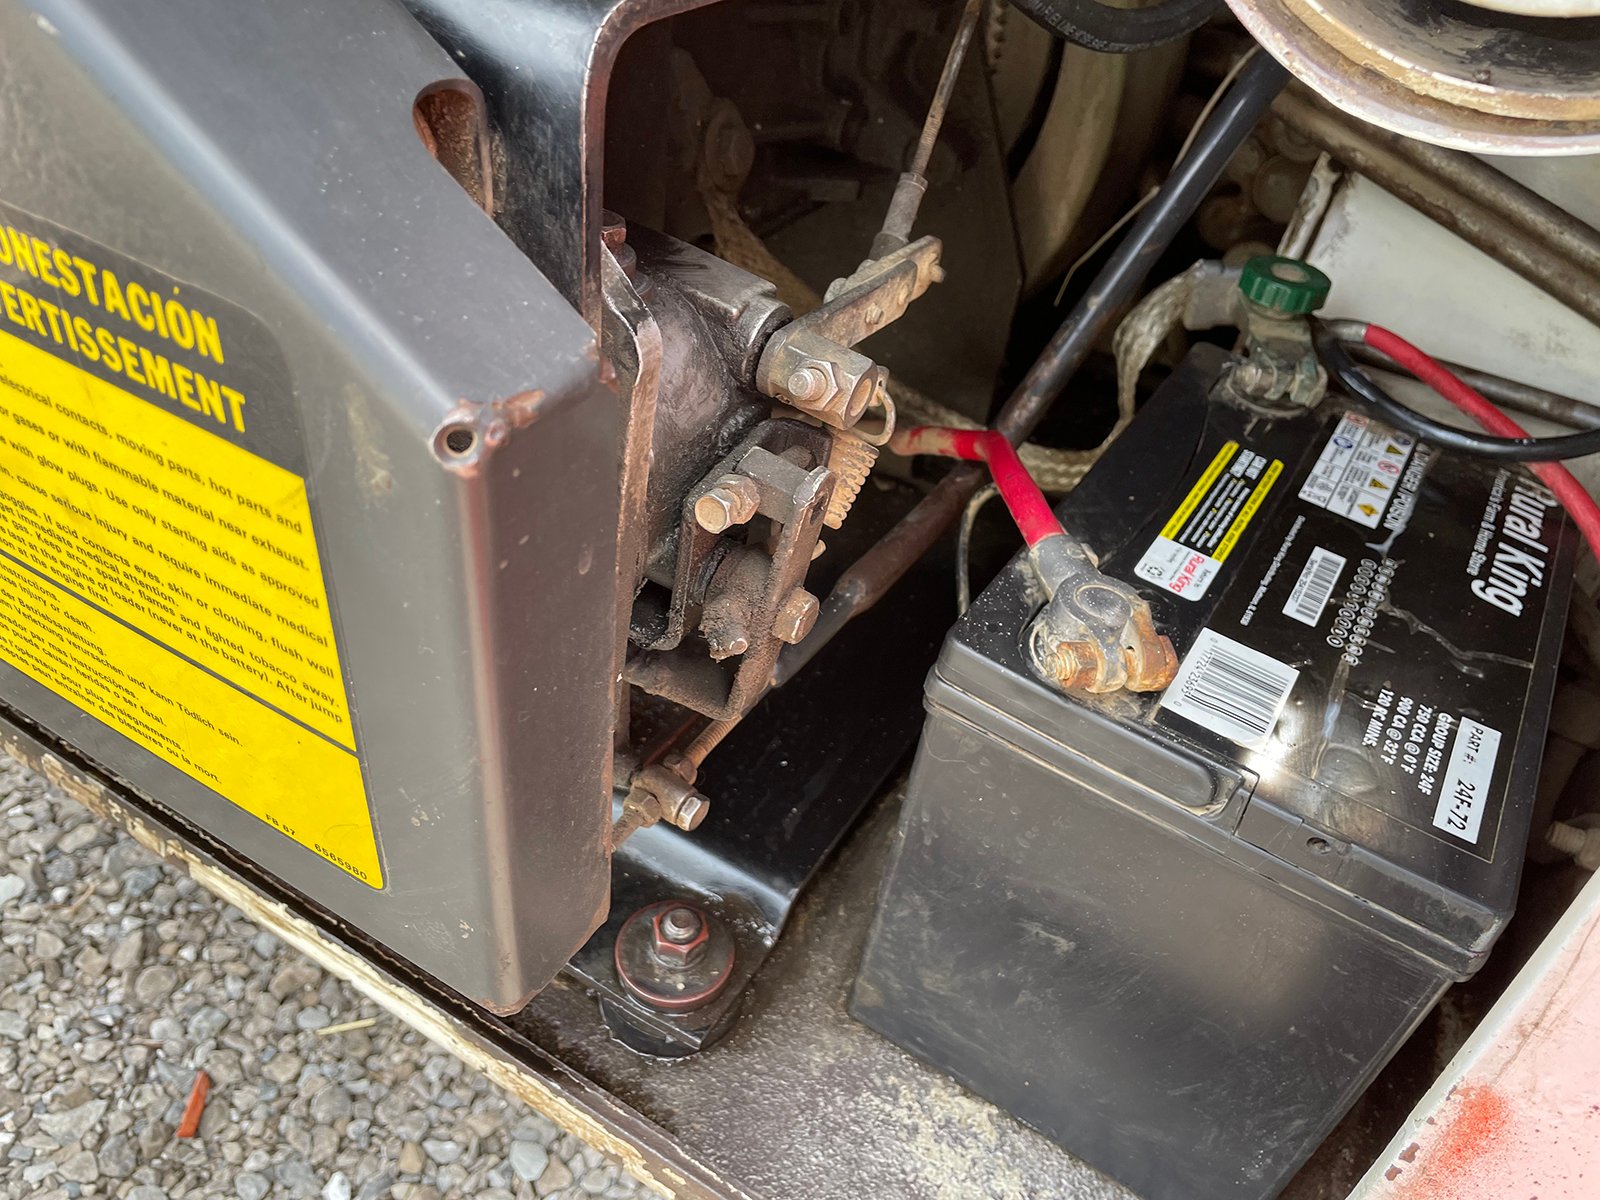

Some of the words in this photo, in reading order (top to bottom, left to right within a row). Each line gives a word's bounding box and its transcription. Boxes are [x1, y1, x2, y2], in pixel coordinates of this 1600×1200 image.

[0, 281, 246, 433] ERTISSEMENT
[55, 403, 112, 438] contacts,
[116, 433, 164, 466] moving
[167, 459, 204, 485] parts,
[208, 477, 232, 498] hot
[236, 494, 271, 518] parts
[276, 514, 301, 533] and
[1400, 451, 1428, 491] DANGER
[12, 413, 45, 435] gases
[47, 431, 59, 442] or
[62, 438, 90, 458] with
[92, 451, 158, 493] flammable
[162, 489, 214, 522] material
[218, 518, 246, 538] near
[251, 535, 309, 571] exhaust.
[1483, 498, 1502, 522] Farm
[9, 440, 33, 458] with
[36, 455, 63, 474] glow
[67, 471, 101, 494] plugs.
[104, 487, 128, 508] Use
[131, 504, 156, 524] only
[161, 519, 207, 552] starting
[211, 546, 236, 565] aids
[241, 561, 255, 574] as
[260, 571, 319, 608] approved
[1382, 491, 1411, 531] POISON
[1481, 520, 1496, 532] &
[1502, 476, 1558, 553] Rural
[15, 509, 73, 548] immediate
[75, 544, 119, 574] medical
[122, 570, 178, 606] attention.
[1474, 528, 1494, 553] Home
[16, 475, 47, 497] cause
[50, 493, 92, 520] serious
[93, 514, 127, 541] injury
[132, 536, 154, 553] and
[157, 550, 200, 578] require
[204, 572, 271, 616] immediate
[276, 614, 327, 647] medical
[17, 546, 28, 558] at
[29, 553, 47, 568] the
[49, 565, 85, 590] engine
[86, 585, 113, 606] first.
[1184, 554, 1205, 578] Rural
[1466, 551, 1487, 576] Store
[1470, 541, 1546, 617] King
[42, 512, 52, 525] If
[55, 521, 78, 539] acid
[81, 536, 130, 567] contacts
[133, 564, 164, 586] eyes,
[167, 582, 192, 601] skin
[196, 598, 208, 609] or
[212, 607, 267, 642] clothing,
[270, 636, 302, 661] flush
[306, 657, 333, 678] well
[1168, 574, 1190, 593] King
[6, 528, 26, 546] last
[27, 541, 39, 553] at
[39, 547, 55, 563] the
[59, 559, 95, 585] engine
[97, 581, 108, 592] of
[109, 586, 145, 612] loader
[147, 607, 182, 633] (never
[186, 630, 198, 643] at
[199, 637, 219, 654] the
[220, 648, 272, 683] battery).
[276, 679, 307, 703] After
[310, 697, 342, 722] jump
[11, 519, 32, 536] gas.
[34, 530, 62, 553] Keep
[65, 550, 91, 570] arcs,
[95, 567, 134, 594] sparks,
[137, 588, 175, 616] flames
[179, 613, 200, 630] and
[204, 625, 244, 654] lighted
[249, 651, 296, 683] tobacco
[302, 681, 339, 708] away.
[18, 582, 46, 606] injury
[50, 603, 60, 613] or
[63, 610, 95, 633] death.
[47, 641, 68, 657] mas
[11, 628, 40, 649] puede
[41, 647, 72, 669] causar
[74, 665, 110, 692] heridas
[122, 696, 137, 708] ser
[140, 705, 166, 726] fatal.
[59, 672, 81, 689] pour
[84, 687, 105, 703] plus
[126, 674, 146, 689] und
[148, 685, 174, 706] kann
[217, 728, 242, 746] sein.
[1372, 705, 1388, 722] RC
[1377, 688, 1395, 708] 120
[1396, 696, 1414, 716] 900
[1416, 704, 1432, 726] 750
[31, 663, 52, 680] peut
[98, 704, 115, 719] des
[116, 714, 163, 748] blessures
[166, 746, 179, 757] ou
[180, 753, 191, 765] la
[193, 763, 221, 783] mort.
[1362, 718, 1384, 747] MINS.
[1386, 727, 1402, 742] @
[1391, 714, 1408, 730] CA
[1409, 724, 1427, 743] CCA
[1430, 712, 1452, 749] GROUP
[1466, 726, 1483, 753] PART
[1404, 742, 1420, 756] @
[1423, 747, 1443, 773] SIZE:
[1418, 772, 1436, 796] 24F
[1447, 778, 1476, 830] 24F-72
[314, 843, 367, 880] 6565980
